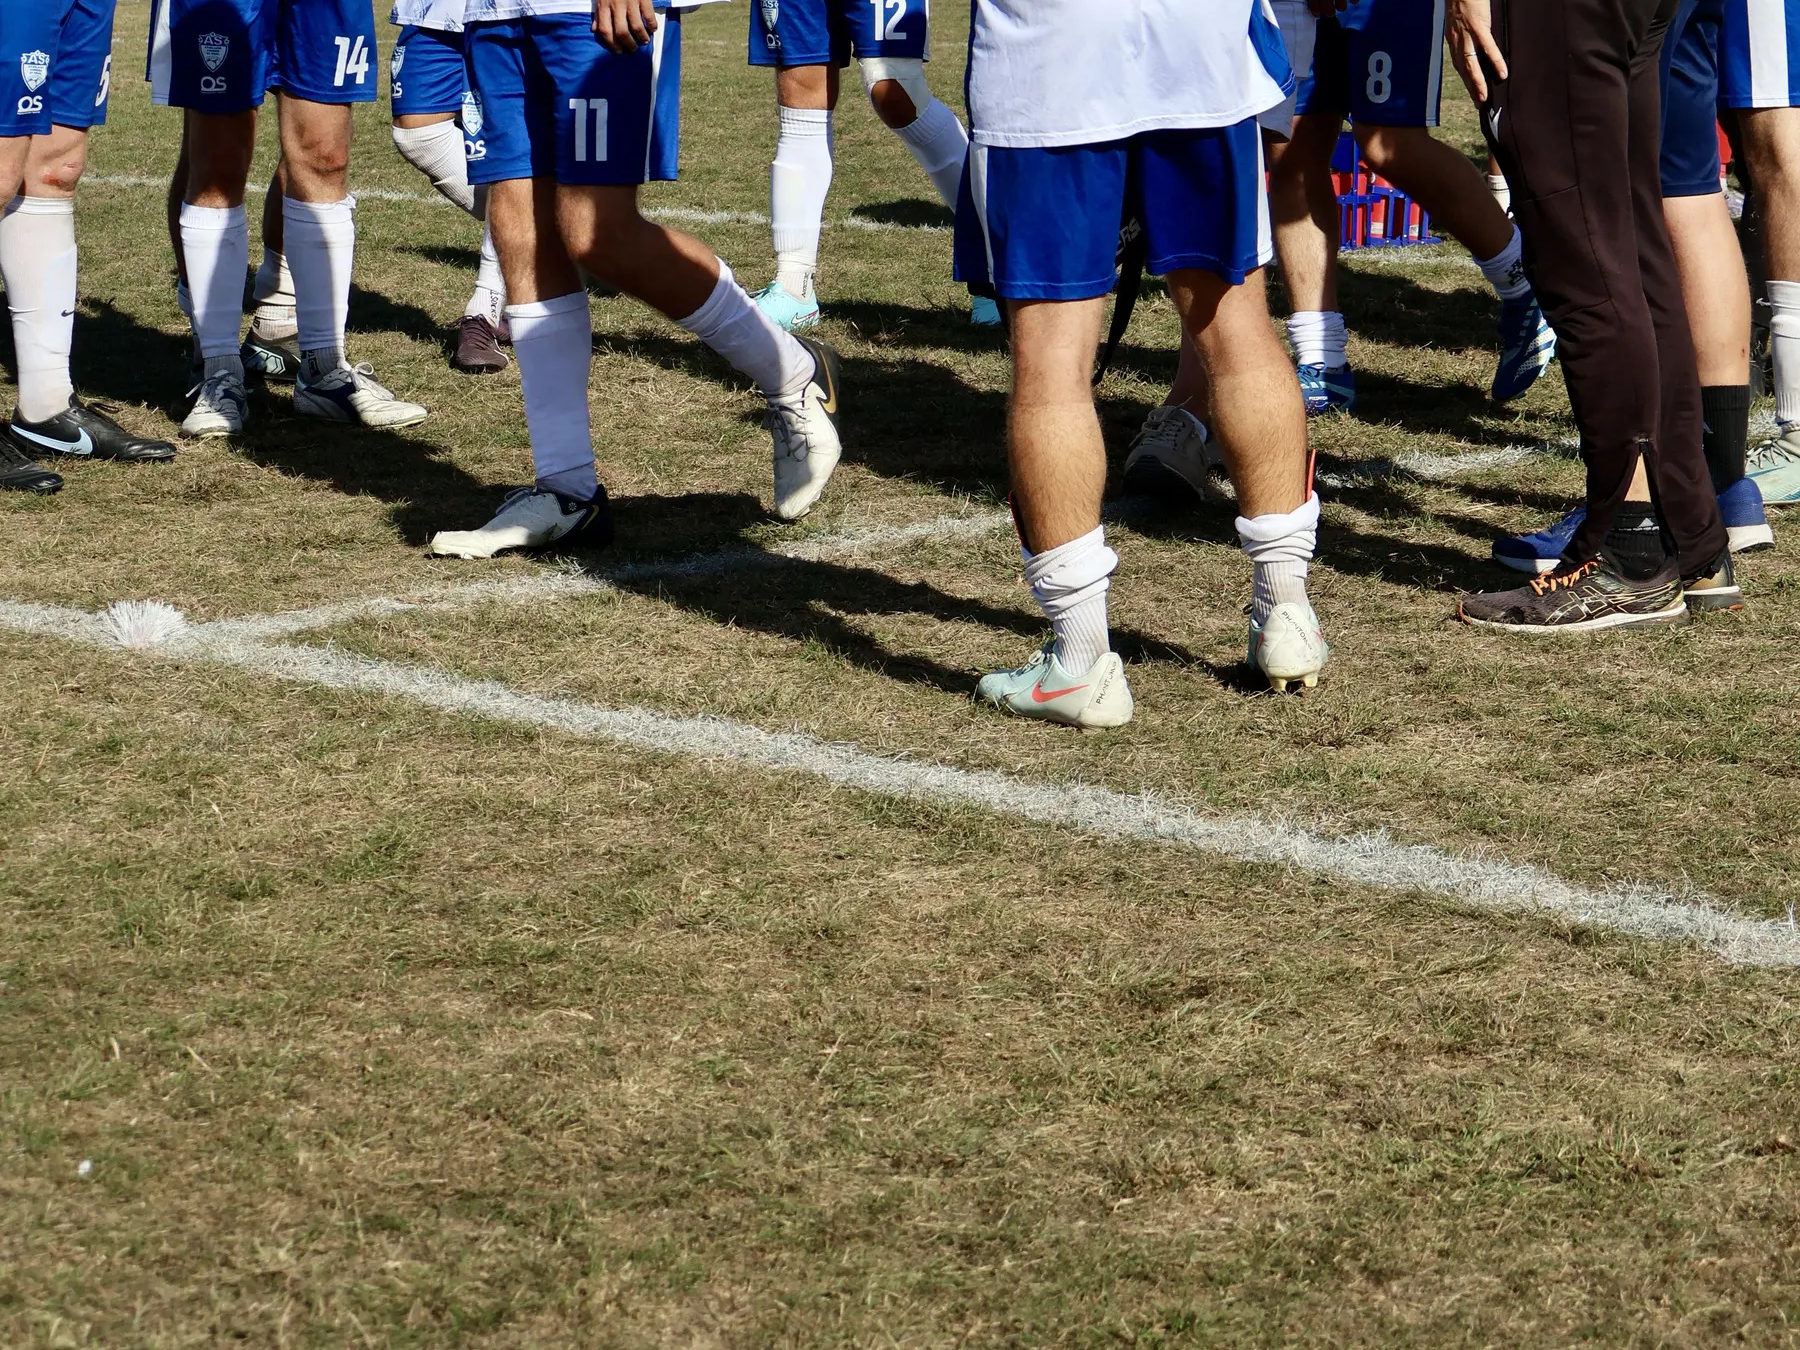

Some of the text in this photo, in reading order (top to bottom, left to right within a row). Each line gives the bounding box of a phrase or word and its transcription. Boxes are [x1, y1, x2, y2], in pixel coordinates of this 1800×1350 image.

[28, 55, 46, 65] AS
[203, 36, 222, 46] AS
[333, 35, 369, 87] 14
[1366, 51, 1392, 104] 8
[568, 98, 608, 161] 11
